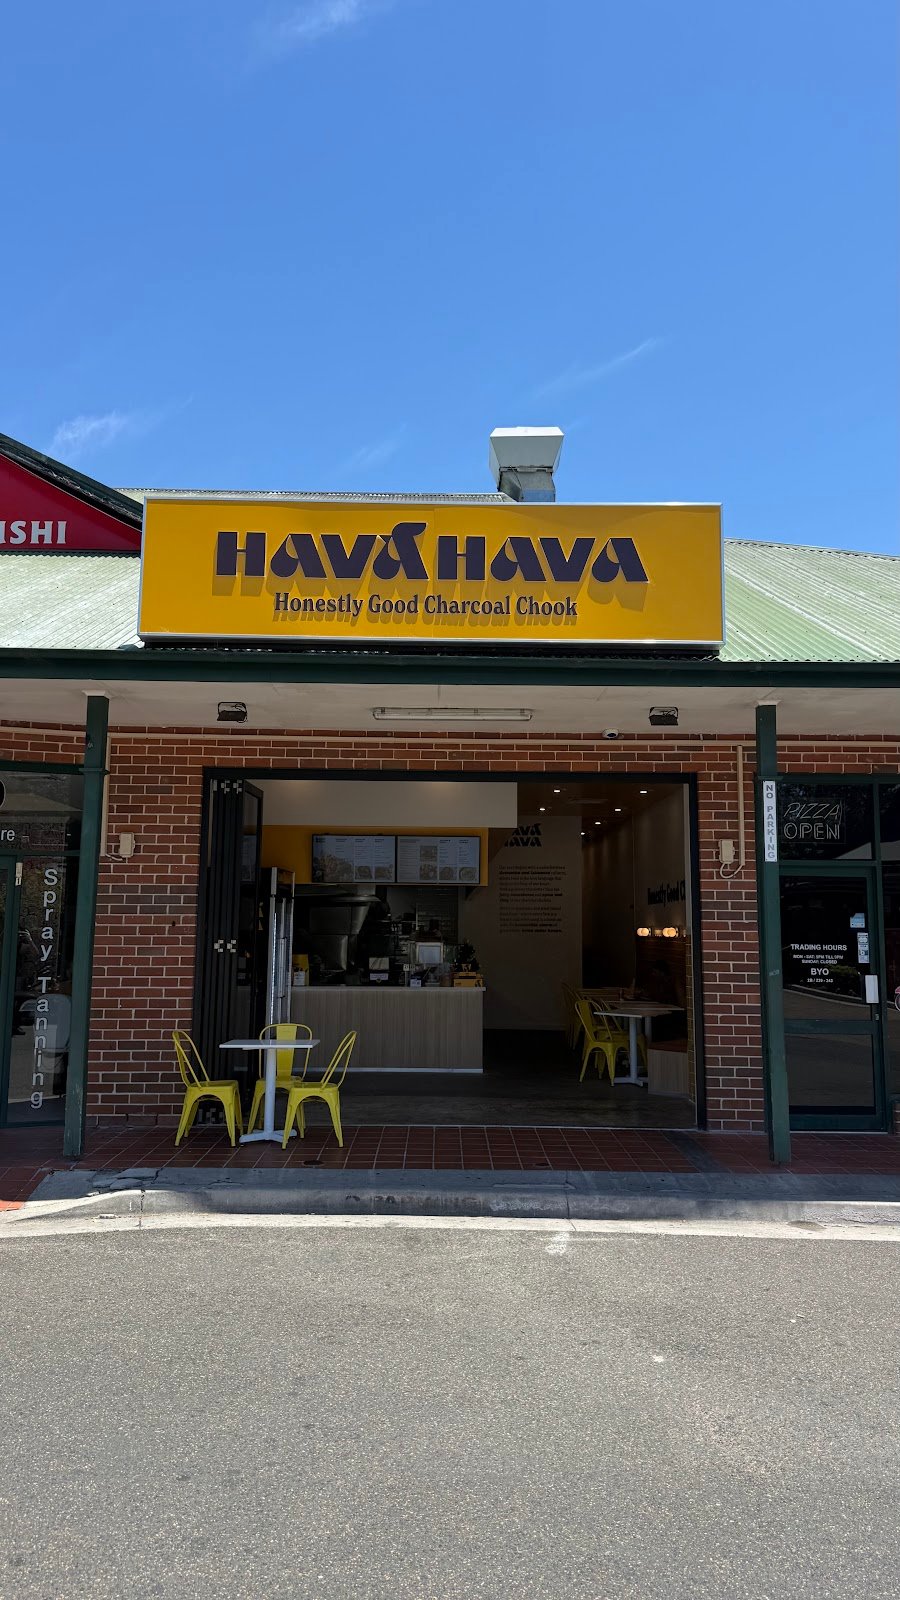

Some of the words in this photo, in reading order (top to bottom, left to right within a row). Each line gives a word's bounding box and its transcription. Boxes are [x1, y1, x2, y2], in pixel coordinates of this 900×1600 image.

[216, 522, 428, 580] HAVA
[438, 536, 649, 583] HAVA
[275, 592, 363, 617] Honestly
[369, 594, 418, 614] Good
[425, 595, 510, 615] Charcoal
[517, 596, 578, 616] Chook
[766, 784, 774, 799] NO
[784, 802, 839, 819] PIZZA
[511, 823, 541, 835] AVA
[767, 806, 775, 858] PARKING
[784, 822, 840, 839] OPEN
[40, 868, 58, 962] Spray
[810, 968, 829, 976] BYO
[30, 976, 52, 1109] Tanning
